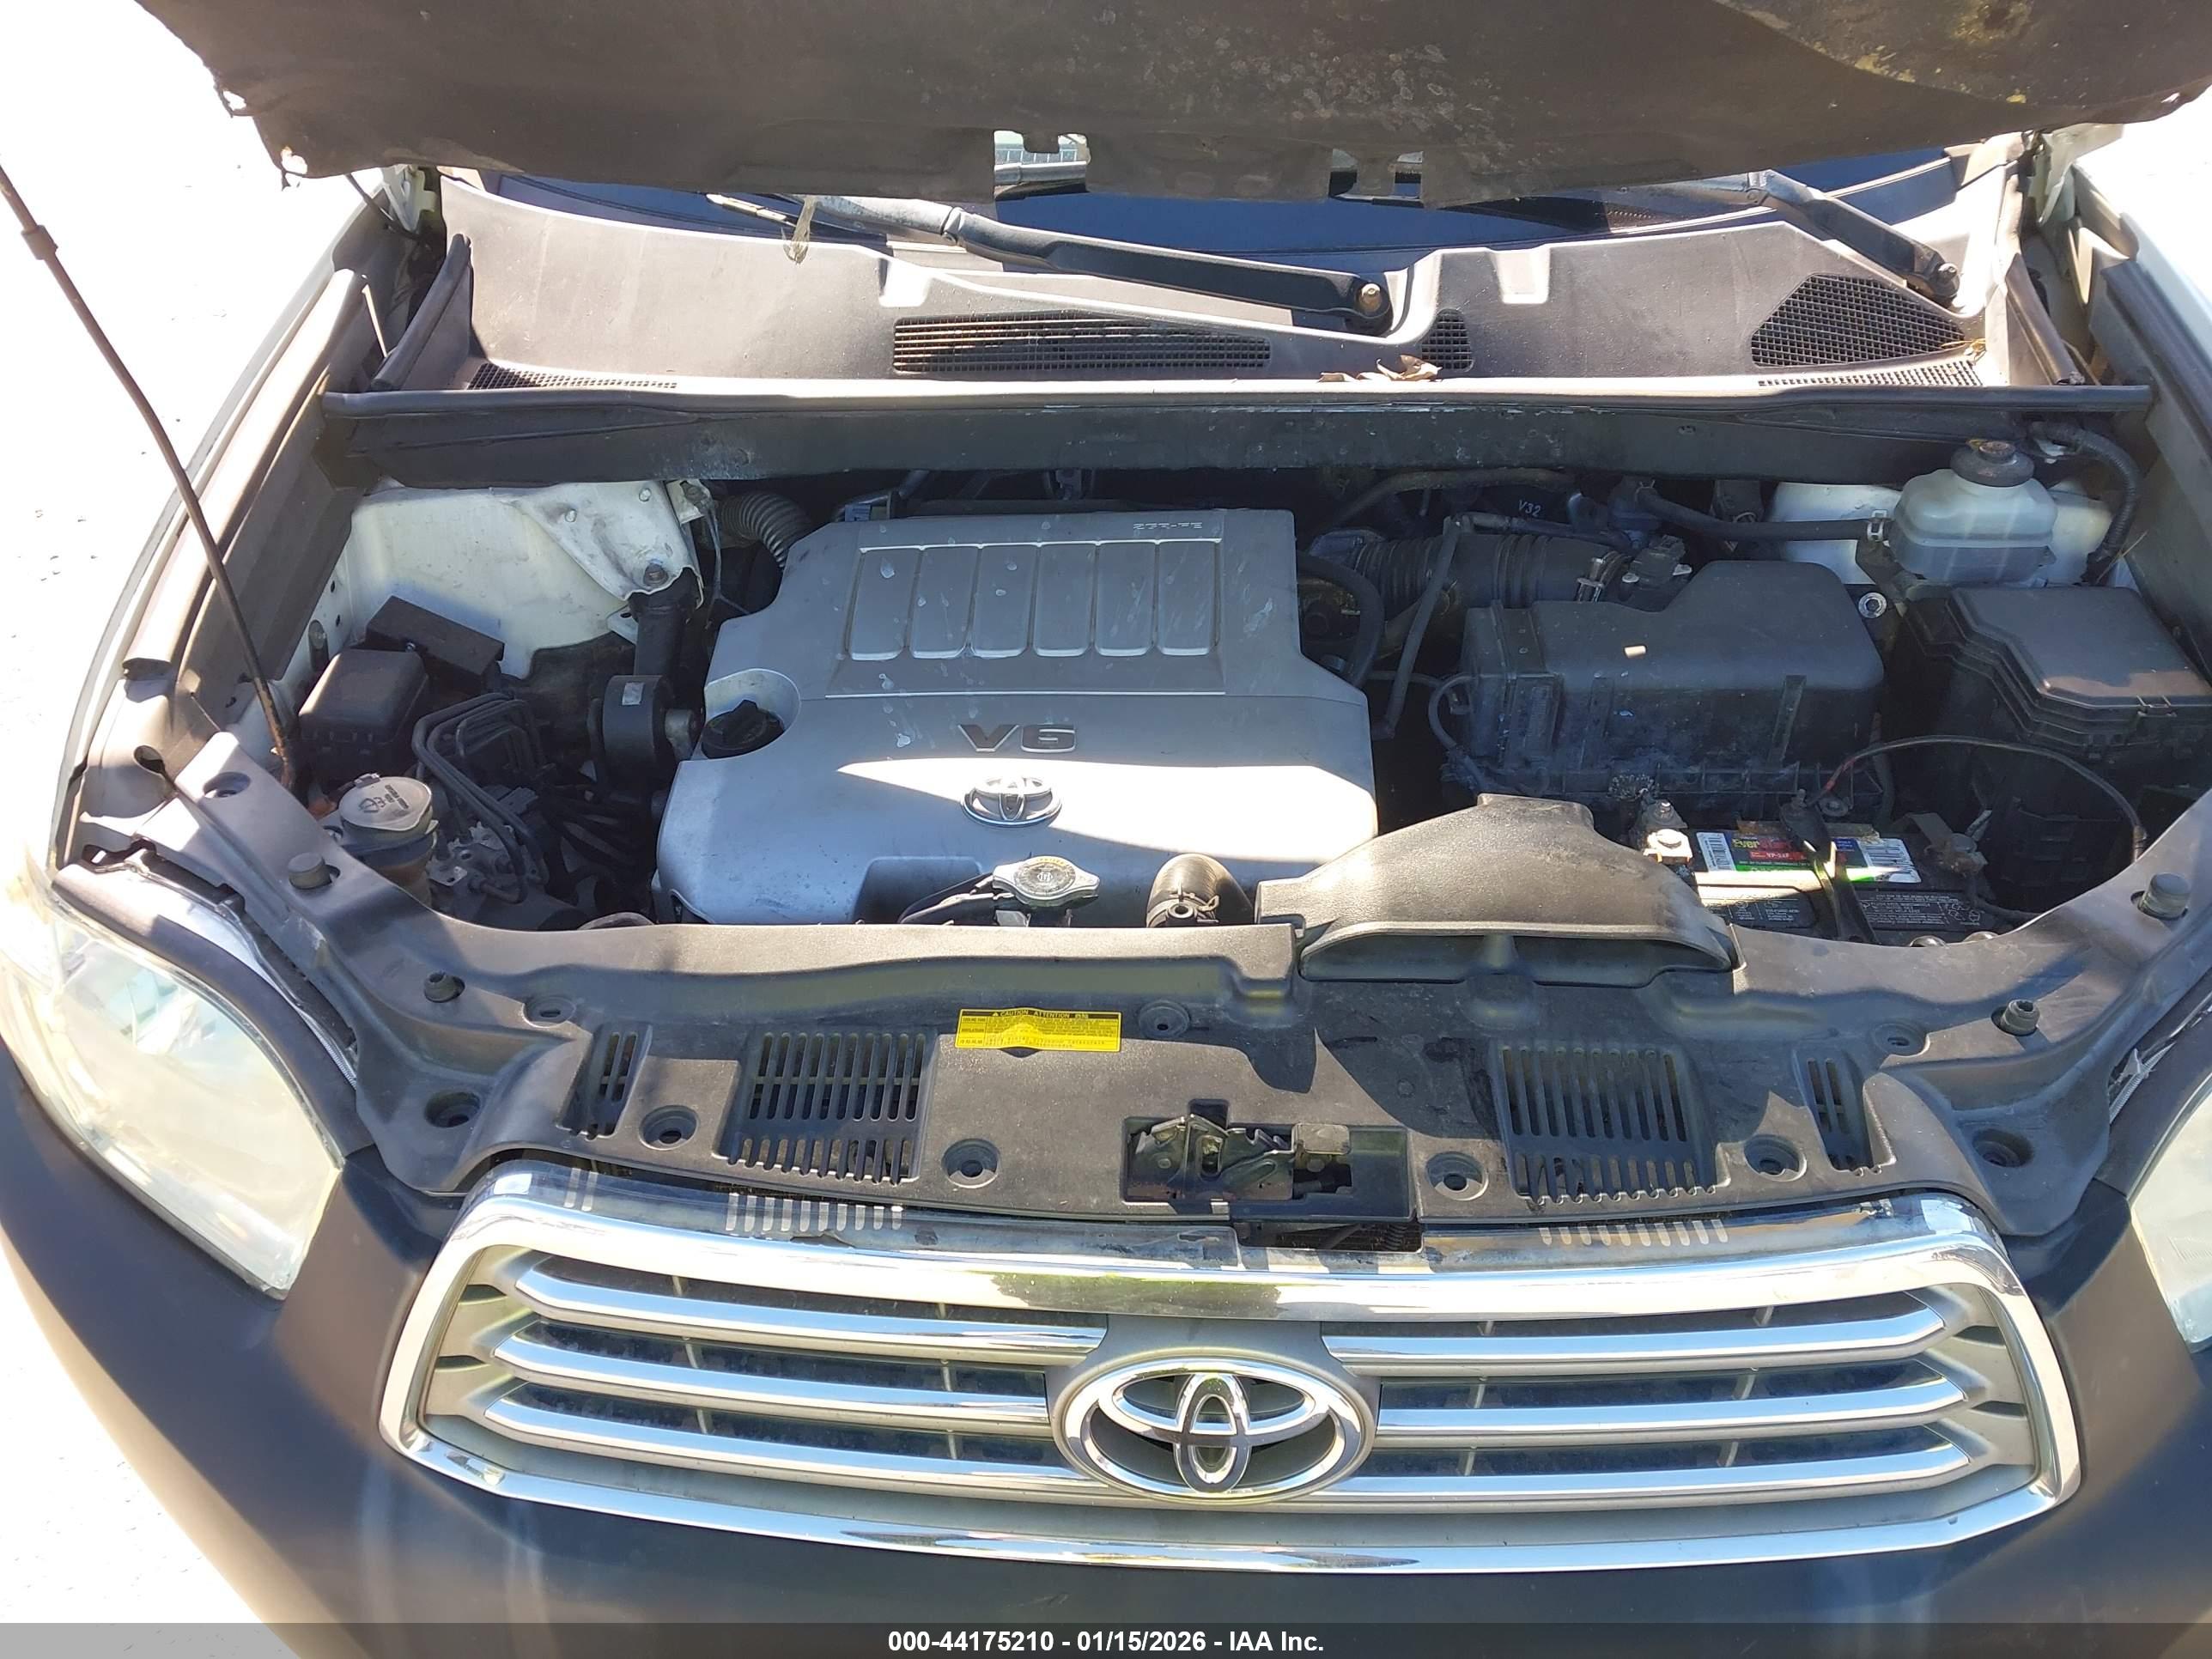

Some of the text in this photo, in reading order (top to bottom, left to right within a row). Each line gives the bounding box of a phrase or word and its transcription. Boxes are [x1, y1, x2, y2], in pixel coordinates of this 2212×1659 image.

[1518, 499, 1541, 517] V32
[957, 724, 1076, 753] V6
[1033, 1011, 1070, 1019] ATTENTION
